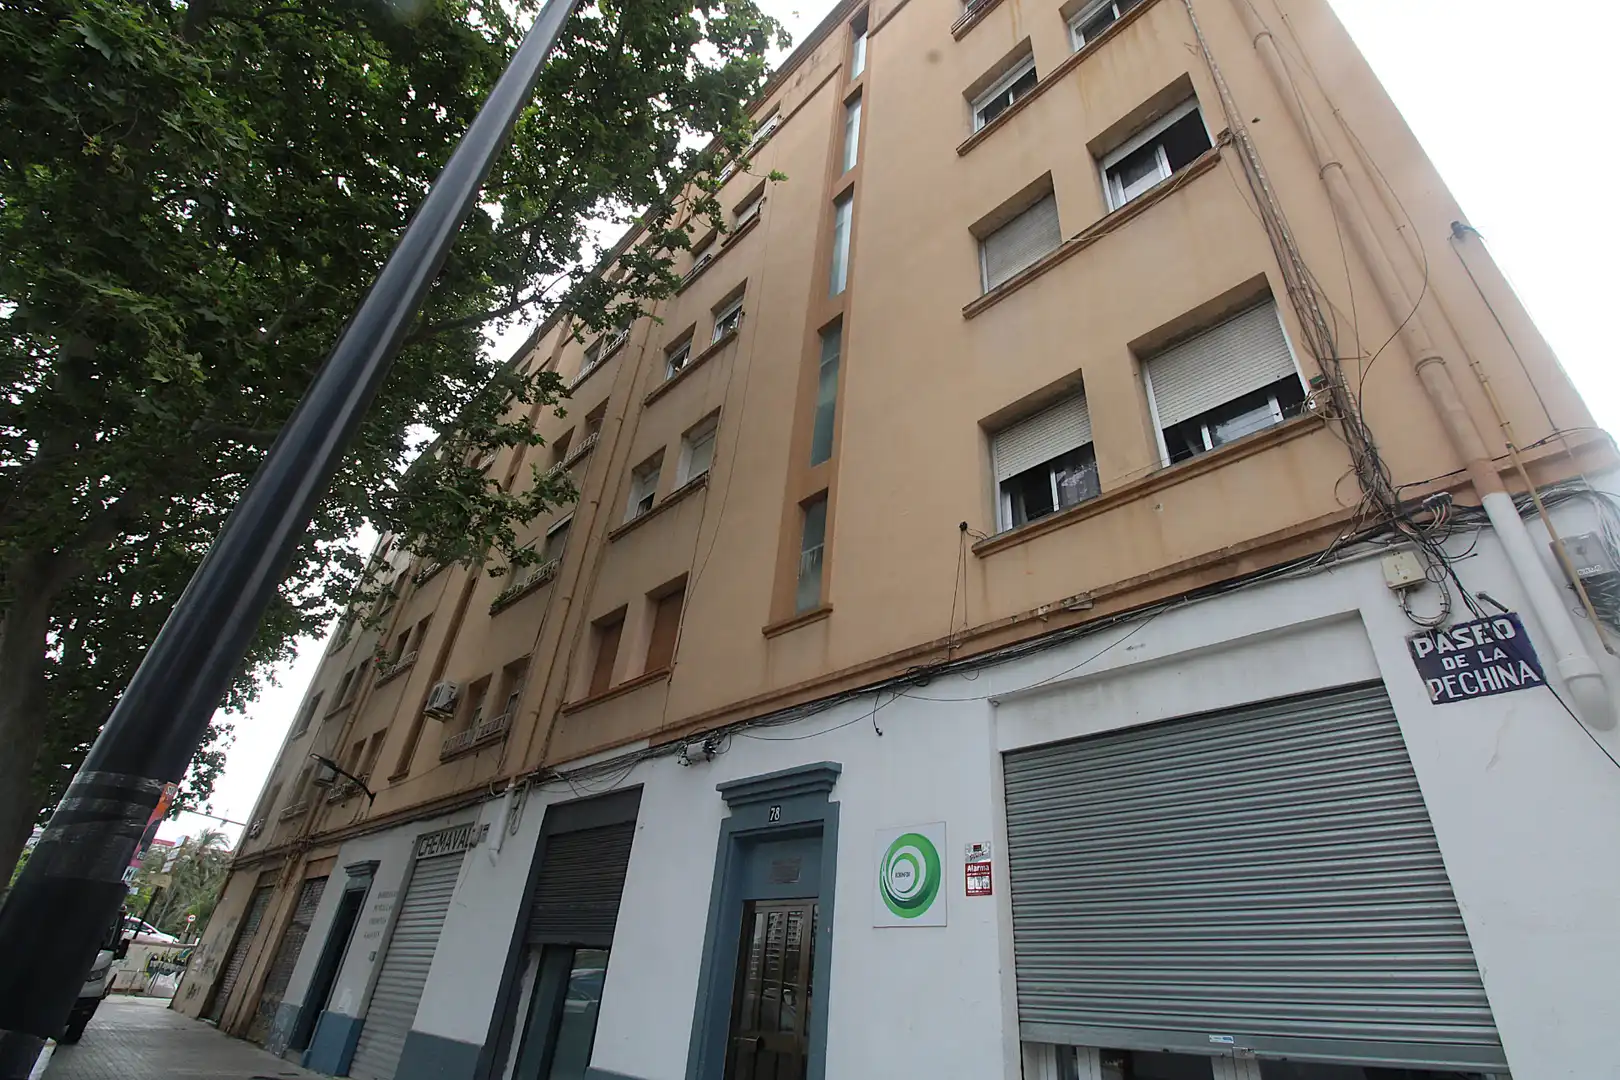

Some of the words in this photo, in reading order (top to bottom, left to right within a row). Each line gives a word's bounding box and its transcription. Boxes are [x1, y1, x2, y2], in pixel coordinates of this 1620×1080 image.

[1413, 618, 1516, 659] PASEO
[1441, 653, 1470, 671] DE
[1479, 647, 1509, 663] LA
[1426, 660, 1541, 701] PECHINA
[769, 806, 781, 821] 78
[966, 864, 990, 873] Alarma
